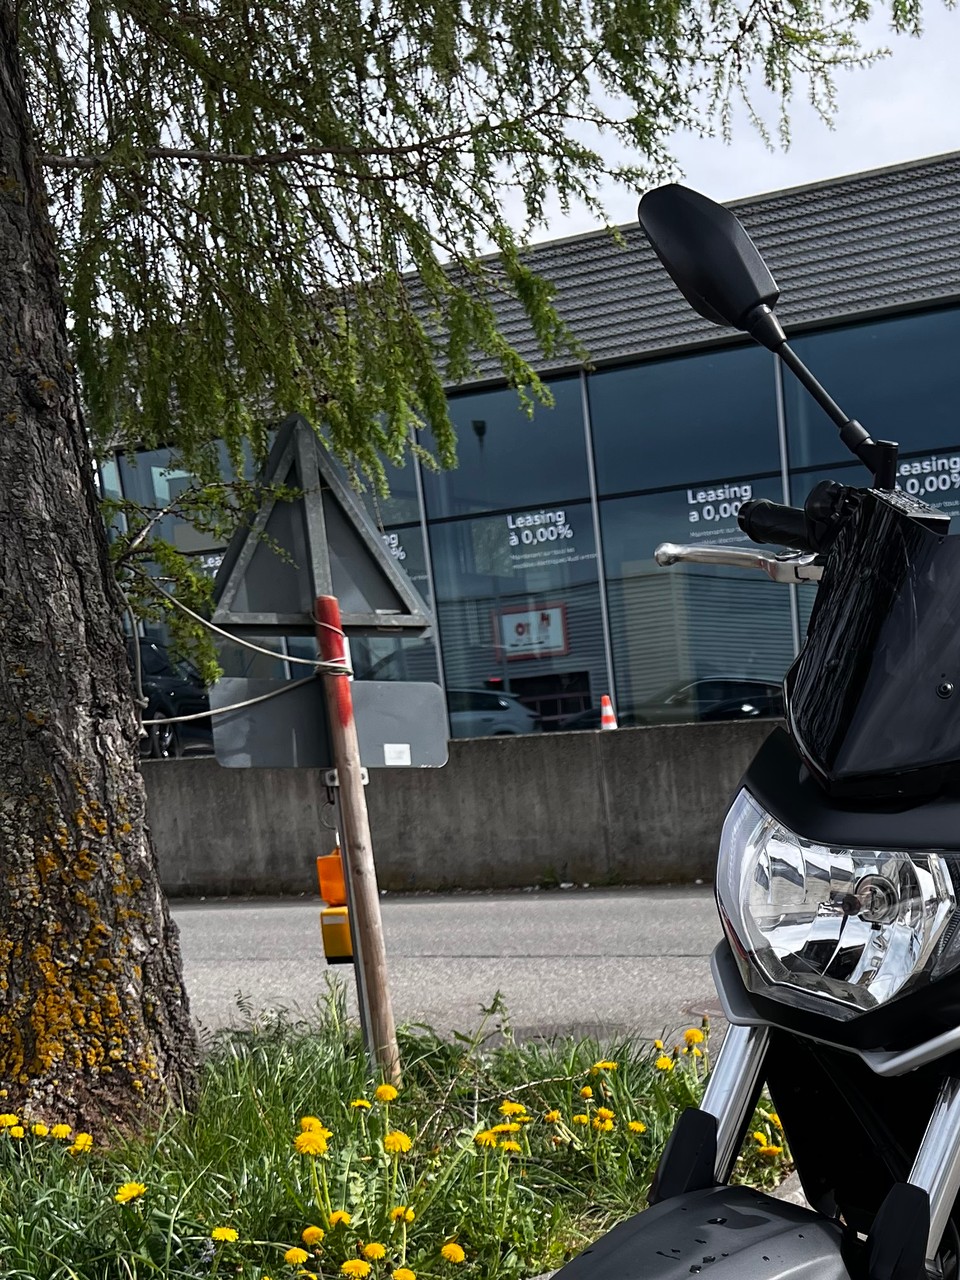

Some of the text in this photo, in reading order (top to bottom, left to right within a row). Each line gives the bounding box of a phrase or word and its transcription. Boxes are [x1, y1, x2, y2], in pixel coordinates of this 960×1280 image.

[896, 456, 960, 477] easing
[687, 484, 752, 504] Leasing
[506, 510, 566, 529] Leasing
[702, 501, 741, 521] 0,00
[521, 524, 573, 545] 0,00%
